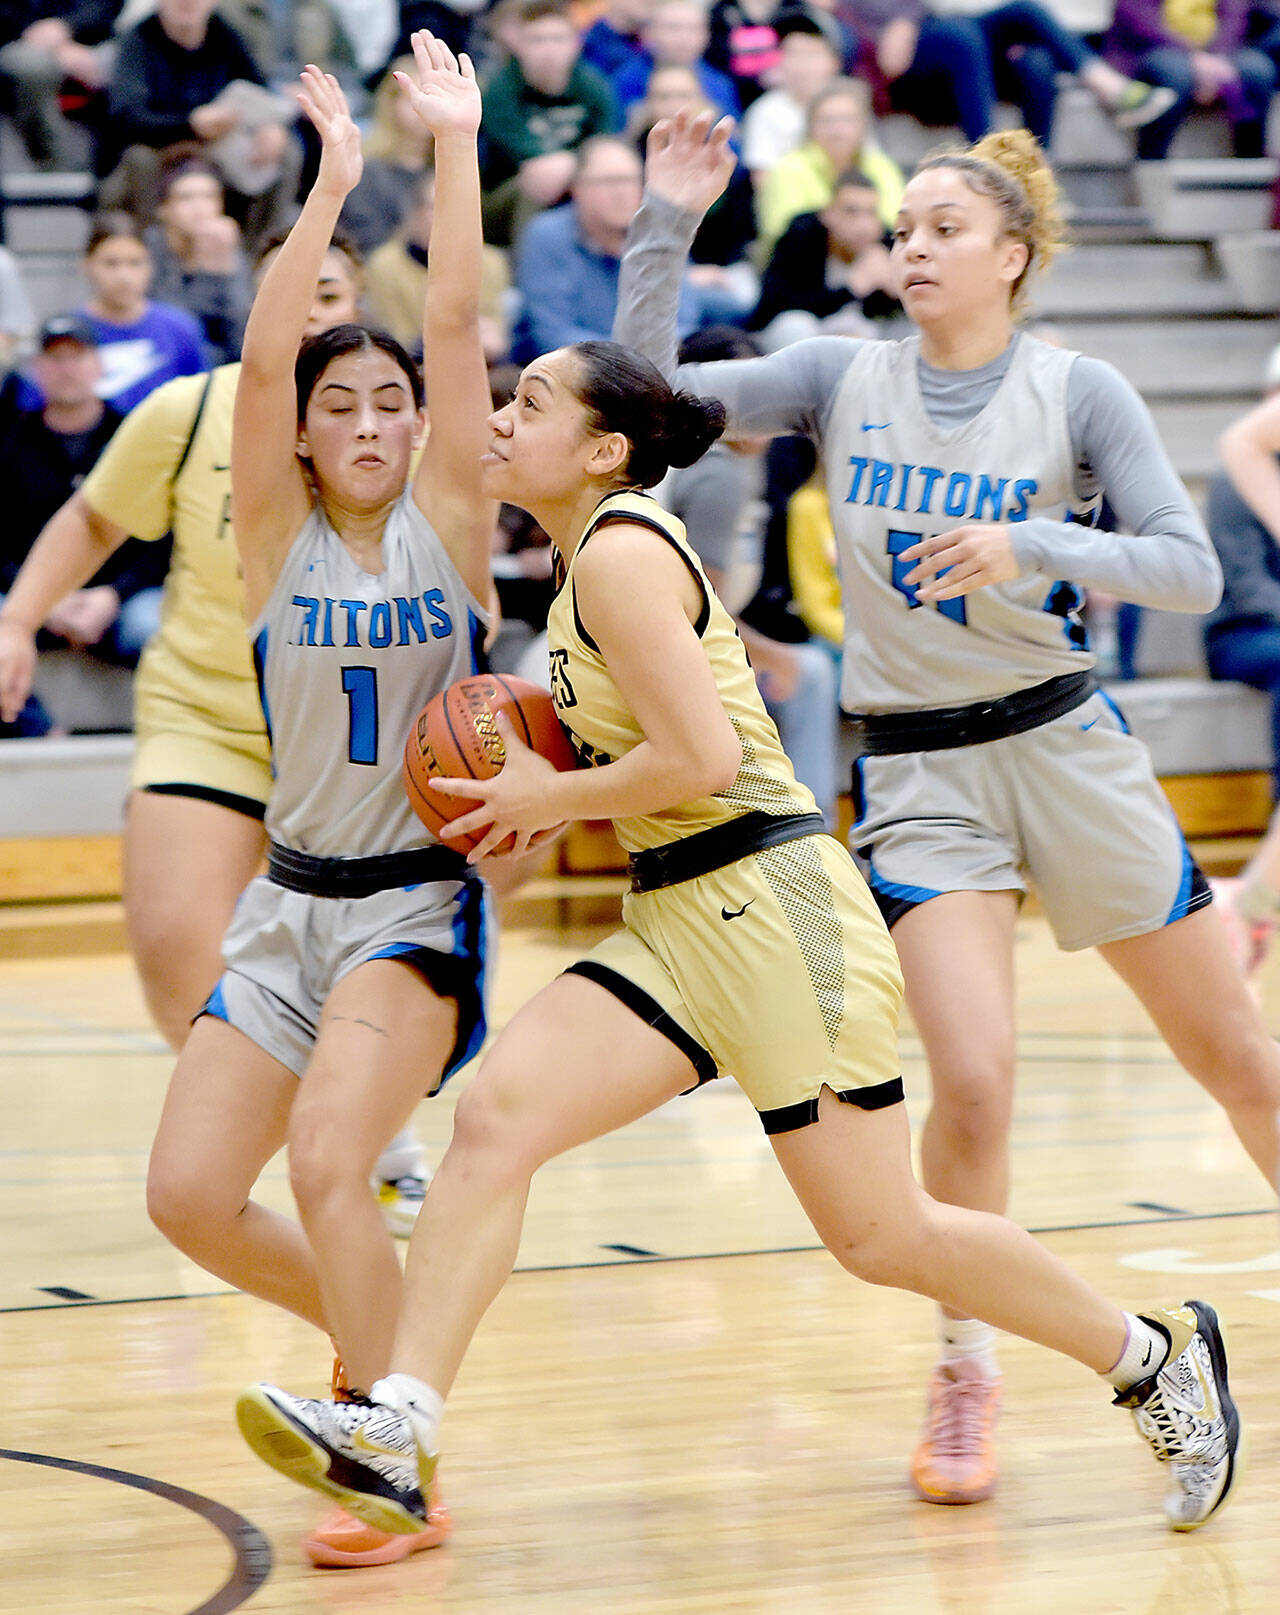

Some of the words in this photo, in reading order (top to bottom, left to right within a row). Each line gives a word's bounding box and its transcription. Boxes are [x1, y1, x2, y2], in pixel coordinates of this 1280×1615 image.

[844, 455, 1038, 523] TRITONS
[340, 665, 379, 767] 1
[417, 711, 448, 780] ELIT
